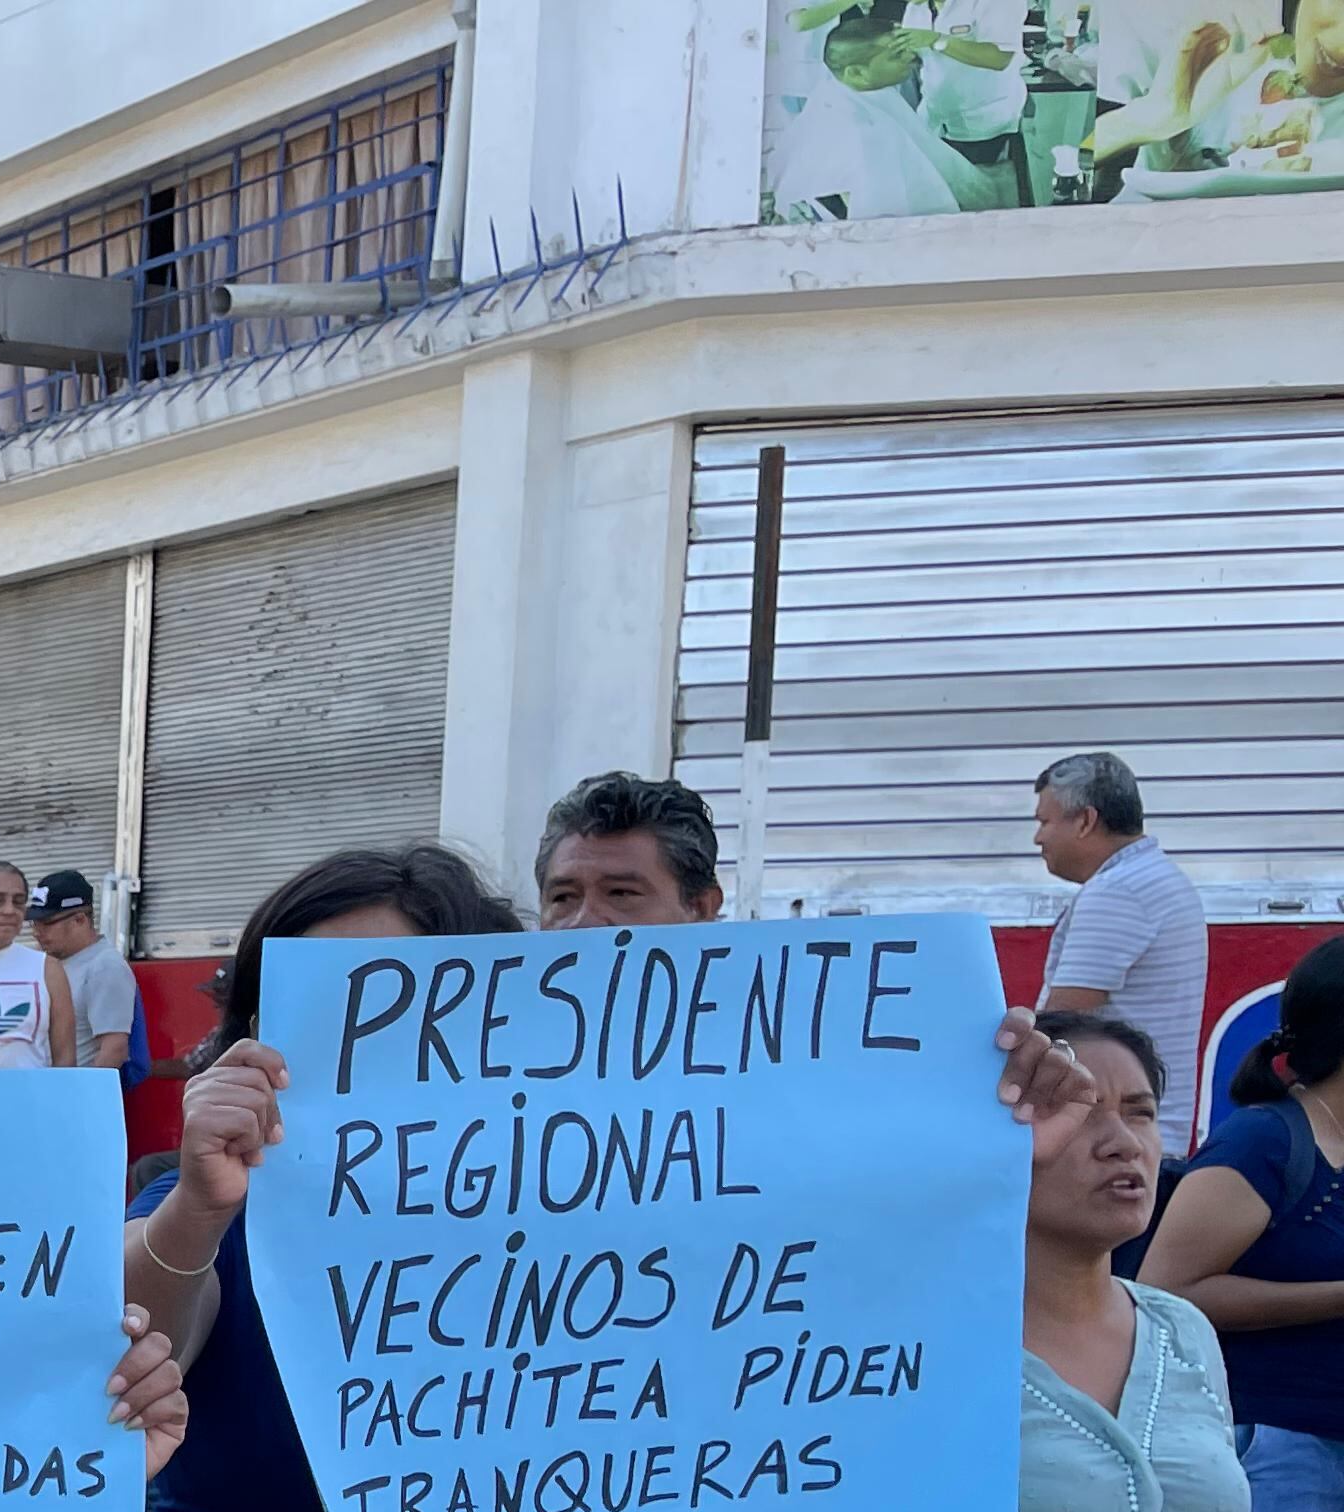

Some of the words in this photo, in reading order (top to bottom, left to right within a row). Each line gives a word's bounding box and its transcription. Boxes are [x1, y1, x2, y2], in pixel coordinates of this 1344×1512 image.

[336, 929, 920, 1094] PRESIDENTE
[329, 1093, 760, 1218] REGIONAL
[327, 1231, 675, 1361] VECINOS
[713, 1241, 816, 1329] DE
[338, 1353, 667, 1449] PACHITEA
[734, 1331, 922, 1409] PIDEN
